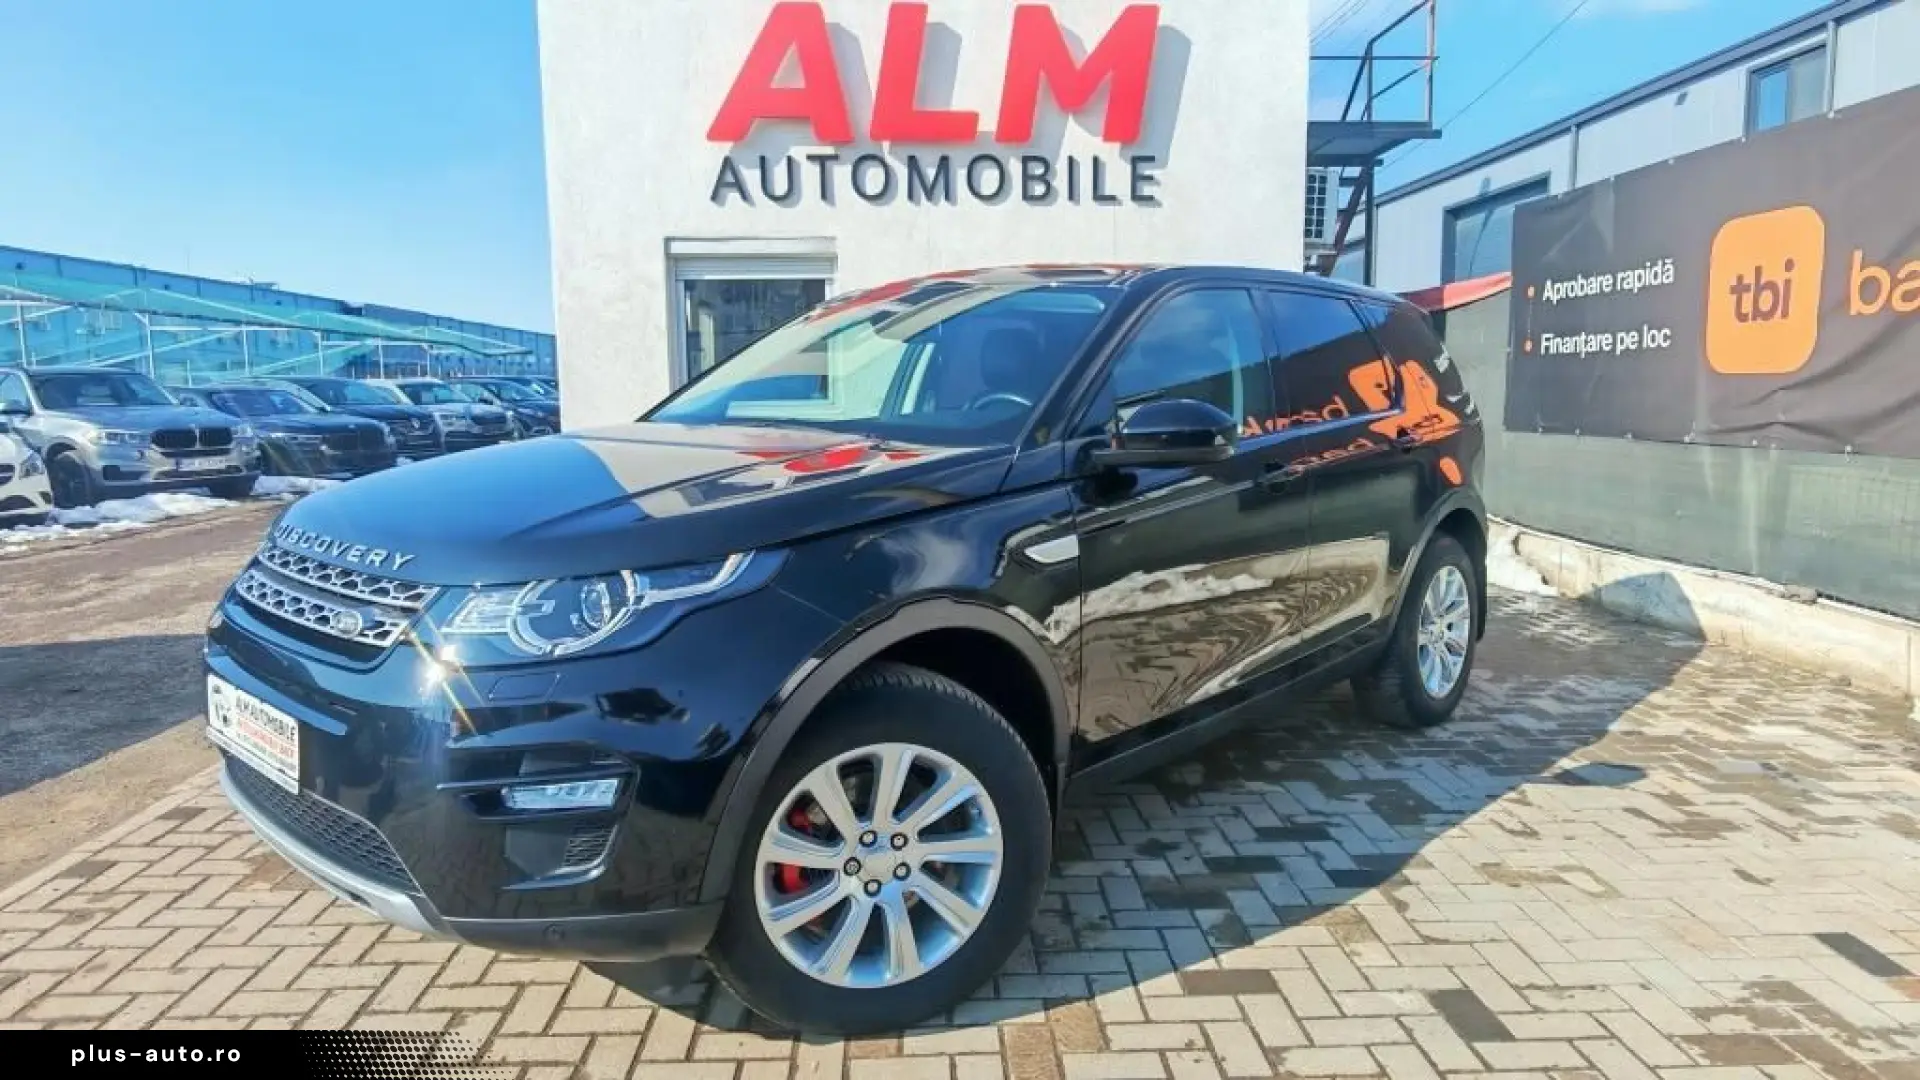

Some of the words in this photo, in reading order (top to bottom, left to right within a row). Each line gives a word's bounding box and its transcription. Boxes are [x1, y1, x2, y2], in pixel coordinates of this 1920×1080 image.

[706, 1, 1161, 144] ALM
[710, 153, 1158, 203] AUTOMOBILE
[1542, 273, 1613, 305] Aprobare
[1615, 258, 1675, 293] rapidă
[1729, 258, 1796, 323] tbi
[1616, 330, 1639, 355] pe
[1643, 324, 1671, 348] loc
